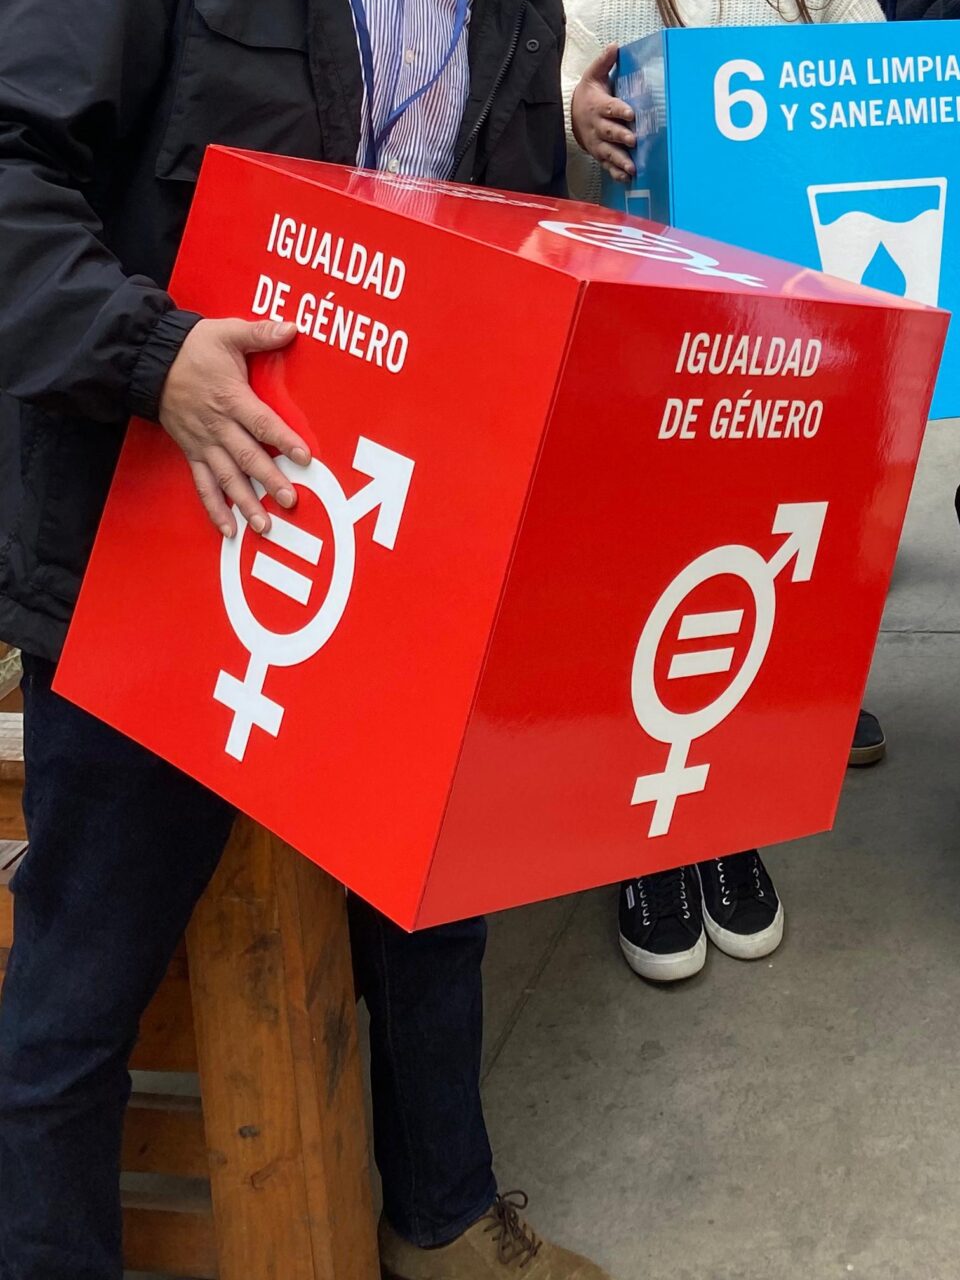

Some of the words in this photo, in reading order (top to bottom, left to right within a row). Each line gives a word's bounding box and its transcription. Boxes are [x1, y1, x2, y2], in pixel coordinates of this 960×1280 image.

[713, 58, 768, 142] 6
[779, 60, 858, 89] AGUA
[780, 103, 799, 131] Y
[267, 212, 407, 301] IGUALDAD
[252, 275, 287, 324] DE
[296, 292, 410, 375] GÉNERO
[675, 332, 823, 378] IGUALDAD
[658, 398, 700, 442] DE
[709, 390, 824, 440] GÉNERO
